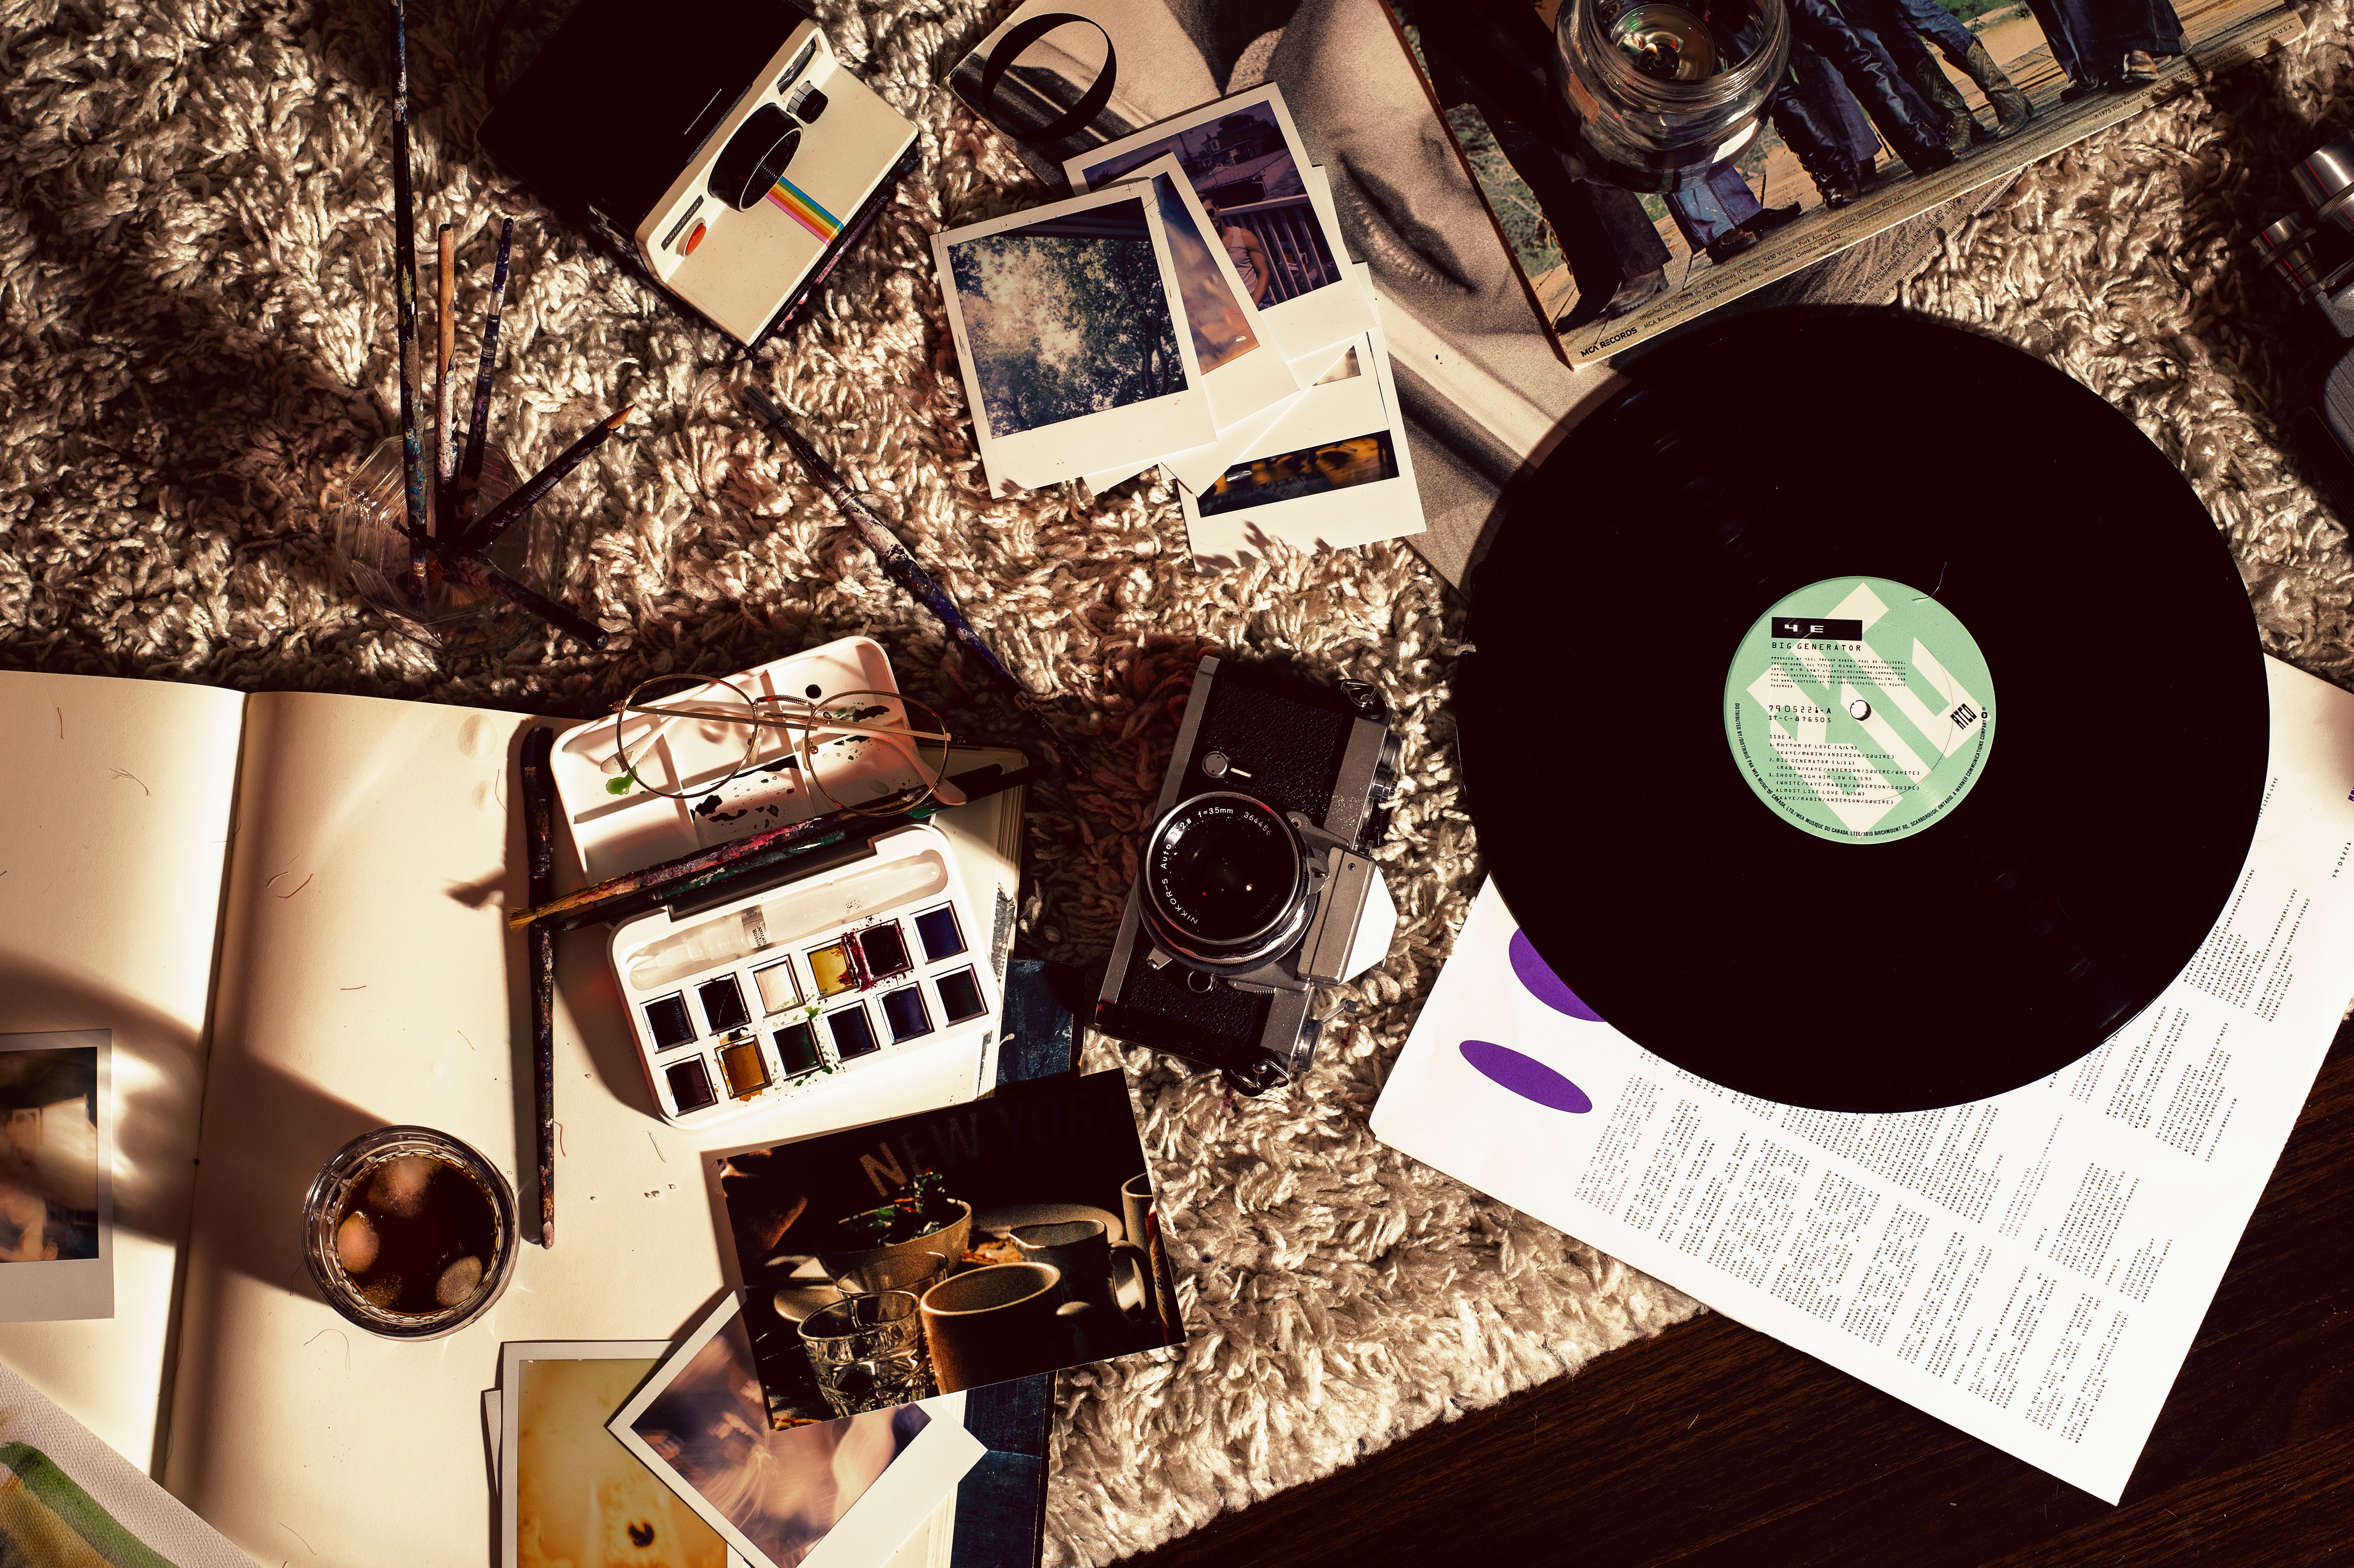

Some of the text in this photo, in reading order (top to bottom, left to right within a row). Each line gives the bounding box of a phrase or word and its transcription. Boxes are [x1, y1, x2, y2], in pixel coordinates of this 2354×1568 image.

[2111, 102, 2122, 111] This
[2122, 94, 2140, 106] Record
[2141, 89, 2151, 97] Co.
[2151, 80, 2170, 93] Limited
[2200, 58, 2219, 70] Record
[2218, 54, 2229, 62] Co.
[2228, 45, 2247, 58] Limited
[2278, 23, 2295, 34] U.S.A.
[1997, 177, 2006, 186] 100
[1977, 184, 1999, 206] Universal
[1933, 209, 1943, 219] OR
[1944, 203, 1957, 215] THIS
[1967, 203, 1979, 215] City
[666, 203, 699, 244] OneStep
[832, 233, 849, 254] LAND
[851, 198, 877, 230] CAMERA
[1910, 225, 1926, 241] PART
[1916, 214, 1945, 242] RECORDING
[1925, 218, 1933, 226] IN
[1888, 249, 1901, 262] ANY
[1899, 248, 1911, 259] THE
[1901, 241, 1910, 250] BY
[1638, 306, 1664, 322] imported
[1663, 301, 1674, 310] by:
[1702, 282, 1716, 291] MCA
[1716, 272, 1737, 285] Records
[1736, 259, 1763, 276] (Canada),
[1763, 253, 1777, 263] 2450
[1777, 243, 1798, 257] Victoria
[1798, 237, 1811, 246] Park
[1826, 215, 1859, 234] Willowdale,
[1881, 199, 1893, 208] M2J
[1893, 193, 1904, 202] 4A2
[1643, 319, 1657, 329] MCA
[1657, 309, 1678, 322] Records
[1678, 297, 1705, 314] (Canada),
[1705, 291, 1718, 300] 2450
[1718, 281, 1739, 294] Victoria
[1763, 254, 1796, 273] Willowdale,
[1818, 238, 1830, 248] M2J
[1830, 233, 1841, 242] 4A2
[1860, 262, 1888, 289] PROCESS
[1874, 257, 1901, 283] PROPERTY
[1856, 290, 1867, 301] THE
[1866, 282, 1875, 291] OF
[1581, 326, 1638, 357] MCA RECORDS
[1797, 643, 1861, 651] GENERATOR
[1950, 703, 1977, 730] ATCO
[1752, 769, 1760, 777] WEA
[1757, 777, 1767, 790] MUSIC
[1805, 818, 1823, 830] MUSIQUE
[1874, 827, 1901, 836] BIRCHMOUNT
[1955, 776, 1968, 793] WARNER
[1966, 741, 1984, 777] COMMUNICATIONS
[1198, 807, 1234, 818] f=35mm
[1243, 812, 1272, 836] 364456
[1160, 844, 1172, 869] Auto
[2332, 869, 2339, 878] 79
[1161, 878, 1199, 924] NIKKOR-S
[752, 928, 761, 947] WINSOR
[2269, 1001, 2281, 1022] MAKING
[2283, 974, 2293, 991] LAUGH
[1665, 1230, 1674, 1243] PAUL
[1695, 1160, 1707, 1180] TREVOR
[1706, 1140, 1716, 1156] HORN.
[2034, 1234, 2044, 1251] VERSE
[1953, 1361, 1966, 1385] DESIGN:
